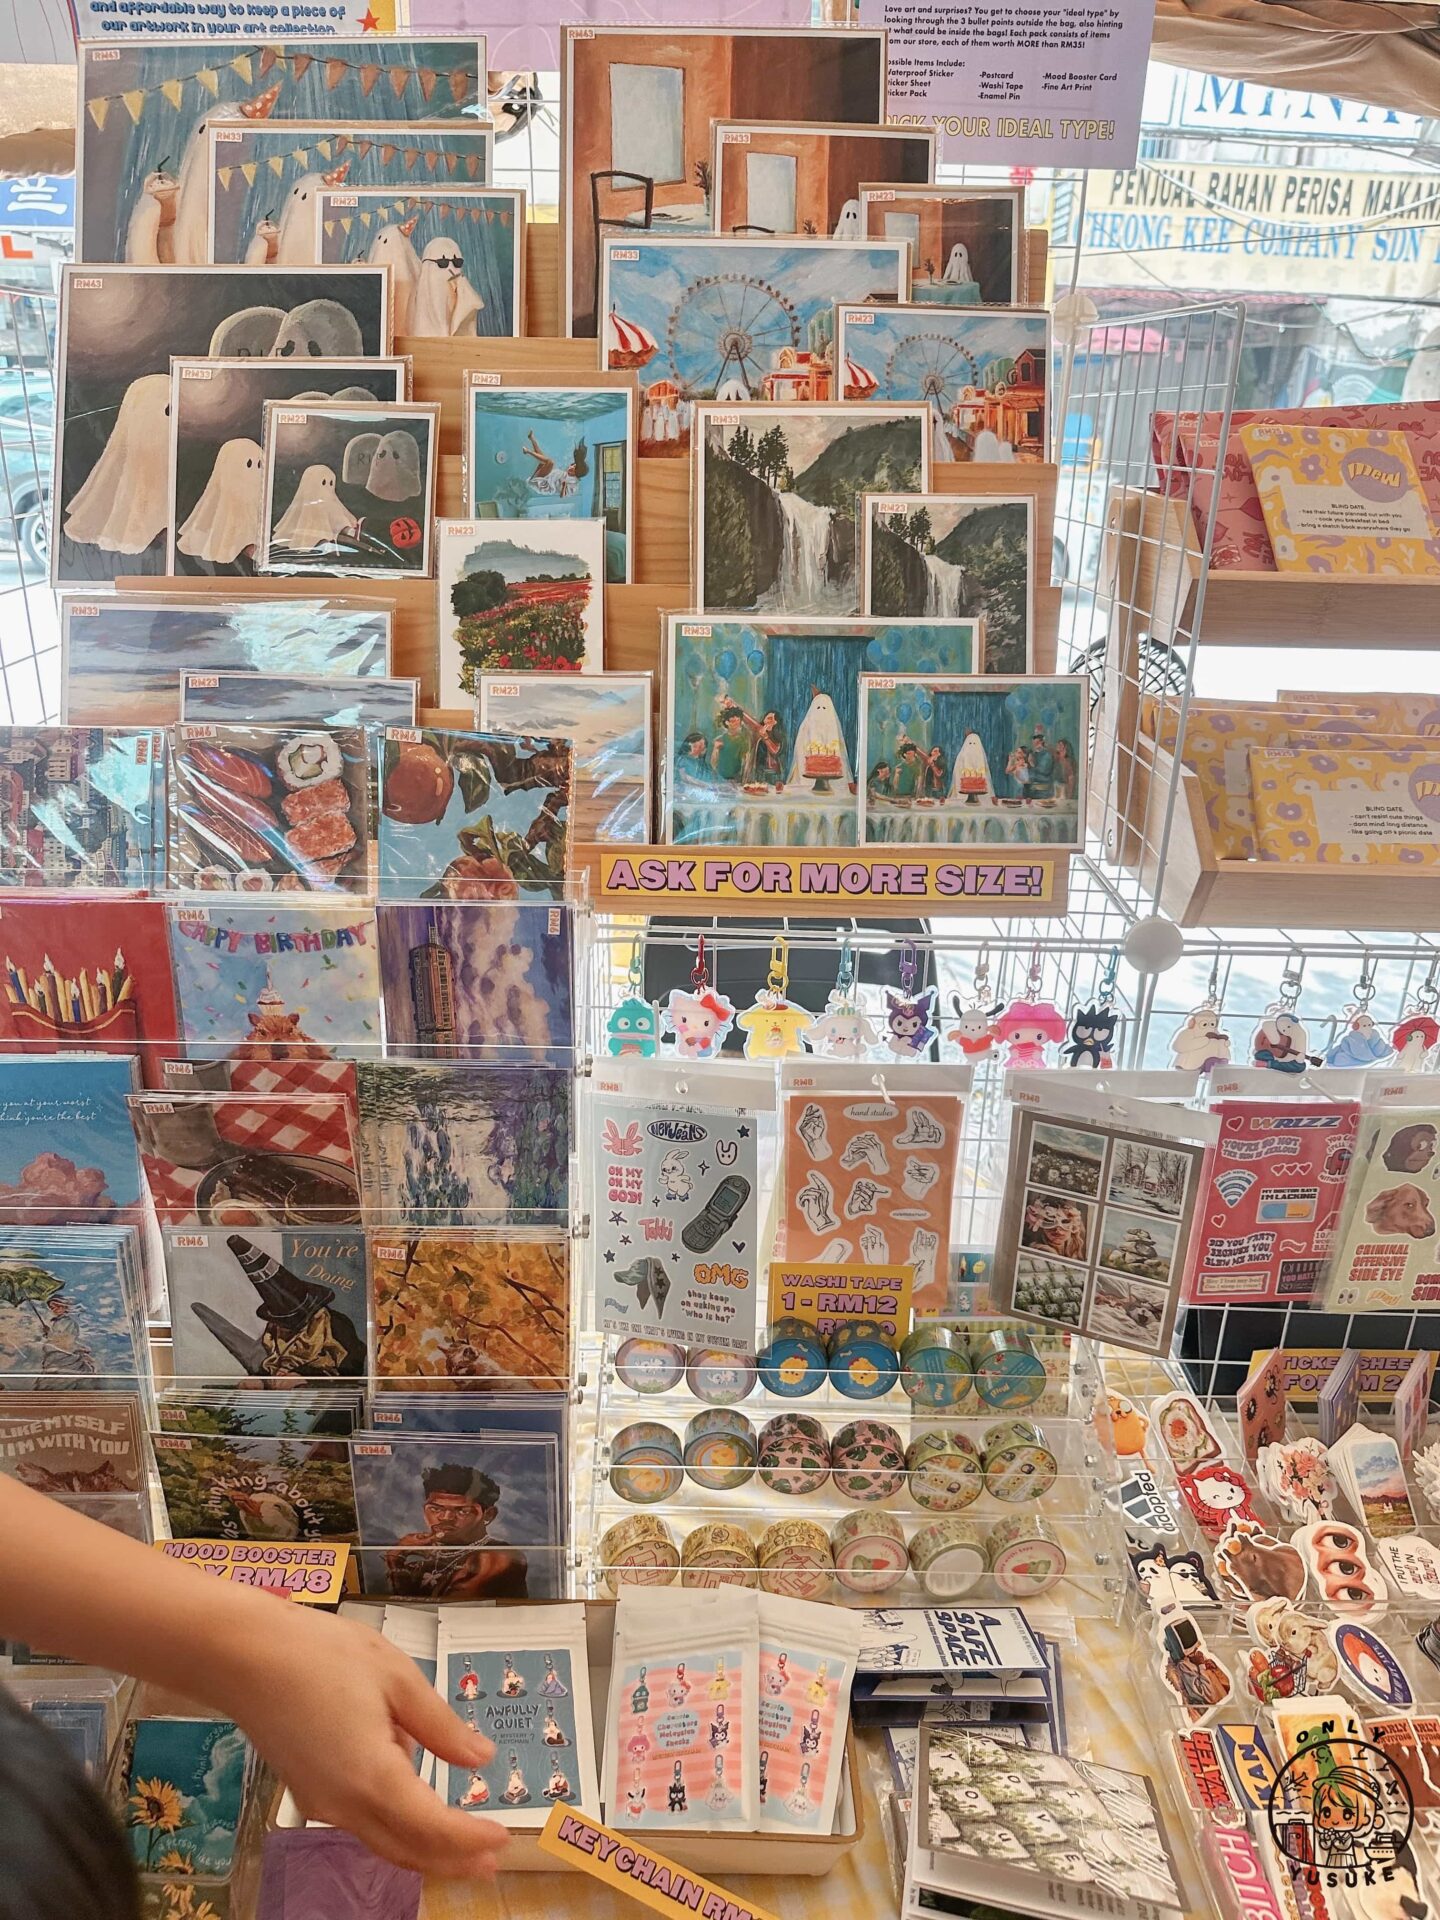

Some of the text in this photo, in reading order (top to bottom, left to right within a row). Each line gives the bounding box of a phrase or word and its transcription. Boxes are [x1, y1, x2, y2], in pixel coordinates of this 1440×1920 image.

[90, 0, 345, 18] and affordable way to keep a piece of
[884, 5, 902, 13] Love
[917, 5, 933, 13] and
[934, 6, 972, 16] surprises?
[974, 7, 989, 15] You
[990, 8, 1003, 17] get
[1014, 8, 1041, 16] choose
[1042, 10, 1061, 18] your
[1063, 8, 1085, 17] "ideal
[1087, 9, 1108, 18] type"
[1109, 9, 1120, 18] by
[101, 21, 127, 31] our
[130, 20, 189, 33] artwork
[191, 19, 205, 33] in
[208, 21, 240, 35] your
[243, 21, 266, 33] art
[884, 15, 913, 25] looking
[915, 17, 945, 26] through
[946, 17, 959, 25] the
[967, 17, 989, 26] bullet
[991, 18, 1014, 27] points
[1016, 19, 1044, 27] outside
[1045, 19, 1058, 27] the
[1079, 20, 1095, 28] also
[1096, 20, 1123, 30] hinting
[569, 28, 594, 39] RM63
[94, 50, 119, 59] RM63
[979, 71, 1117, 81] -Postcard -Mood Booster Card
[1041, 83, 1092, 92] -Fine Art Print
[931, 116, 1115, 141] YOUR IDEAL TYPE!
[216, 131, 241, 141] RM33
[723, 133, 750, 143] RM33
[868, 190, 894, 200] RM23
[1109, 170, 1195, 208] PENJUAL
[1204, 172, 1277, 212] BAHAN
[1282, 176, 1353, 216] PERISA
[332, 196, 357, 206] RM23
[1182, 217, 1234, 254] KEE
[1243, 219, 1364, 259] COMPANY
[1372, 226, 1425, 262] SDN
[613, 250, 639, 260] RM33
[76, 279, 101, 288] RM63
[848, 314, 873, 323] RM23
[184, 369, 211, 379] RM33
[474, 374, 500, 384] RM23
[280, 414, 306, 423] RM23
[712, 415, 739, 424] RM33
[880, 503, 907, 512] RM23
[448, 526, 474, 535] RM23
[72, 606, 98, 616] RM33
[684, 626, 711, 635] RM33
[190, 677, 218, 688] RM23
[868, 679, 895, 688] RM23
[492, 686, 519, 695] RM23
[187, 728, 212, 739] RM6
[391, 729, 417, 741] RM6
[137, 738, 148, 764] RM6
[607, 859, 1043, 896] ASK FOR MORE SIZE!
[177, 908, 205, 921] RM6
[549, 908, 559, 933] RM6
[253, 922, 366, 954] BIRTHDAY
[166, 1063, 192, 1073] RM6
[146, 1103, 171, 1114] RM6
[850, 1106, 894, 1117] hand studies
[1252, 1116, 1341, 1129] WRIZZ
[608, 1165, 643, 1179] OH MY
[608, 1176, 643, 1190] OH MY
[608, 1189, 643, 1205] GOD!
[177, 1236, 204, 1246] RM6
[291, 1239, 359, 1258] You're
[379, 1248, 404, 1259] RM6
[1356, 1244, 1409, 1255] CRIMINAL
[1353, 1256, 1407, 1267] OFFENSIVE
[305, 1263, 354, 1293] Doing
[693, 1262, 749, 1289] OMG
[1349, 1268, 1404, 1281] SIDE EYE
[781, 1273, 903, 1291] WASHI TAPE
[781, 1292, 898, 1315] 1 RM12
[160, 1410, 185, 1420] RM6
[377, 1413, 401, 1422] RM6
[0, 1415, 126, 1439] LIKE MYSELF
[36, 1433, 130, 1455] WITH YOU
[159, 1439, 187, 1449] RM6
[360, 1445, 386, 1454] RM6
[201, 1474, 325, 1529] thinking about
[162, 1542, 336, 1566] MOOD BOOSTER
[1405, 1553, 1416, 1564] IN
[1389, 1546, 1407, 1580] PUT THE
[934, 1610, 972, 1666] SPACE
[953, 1611, 994, 1665] SAFE
[485, 1704, 540, 1718] AWFULLY
[493, 1717, 533, 1730] QUIET
[558, 1815, 704, 1910] KEYCHAIN
